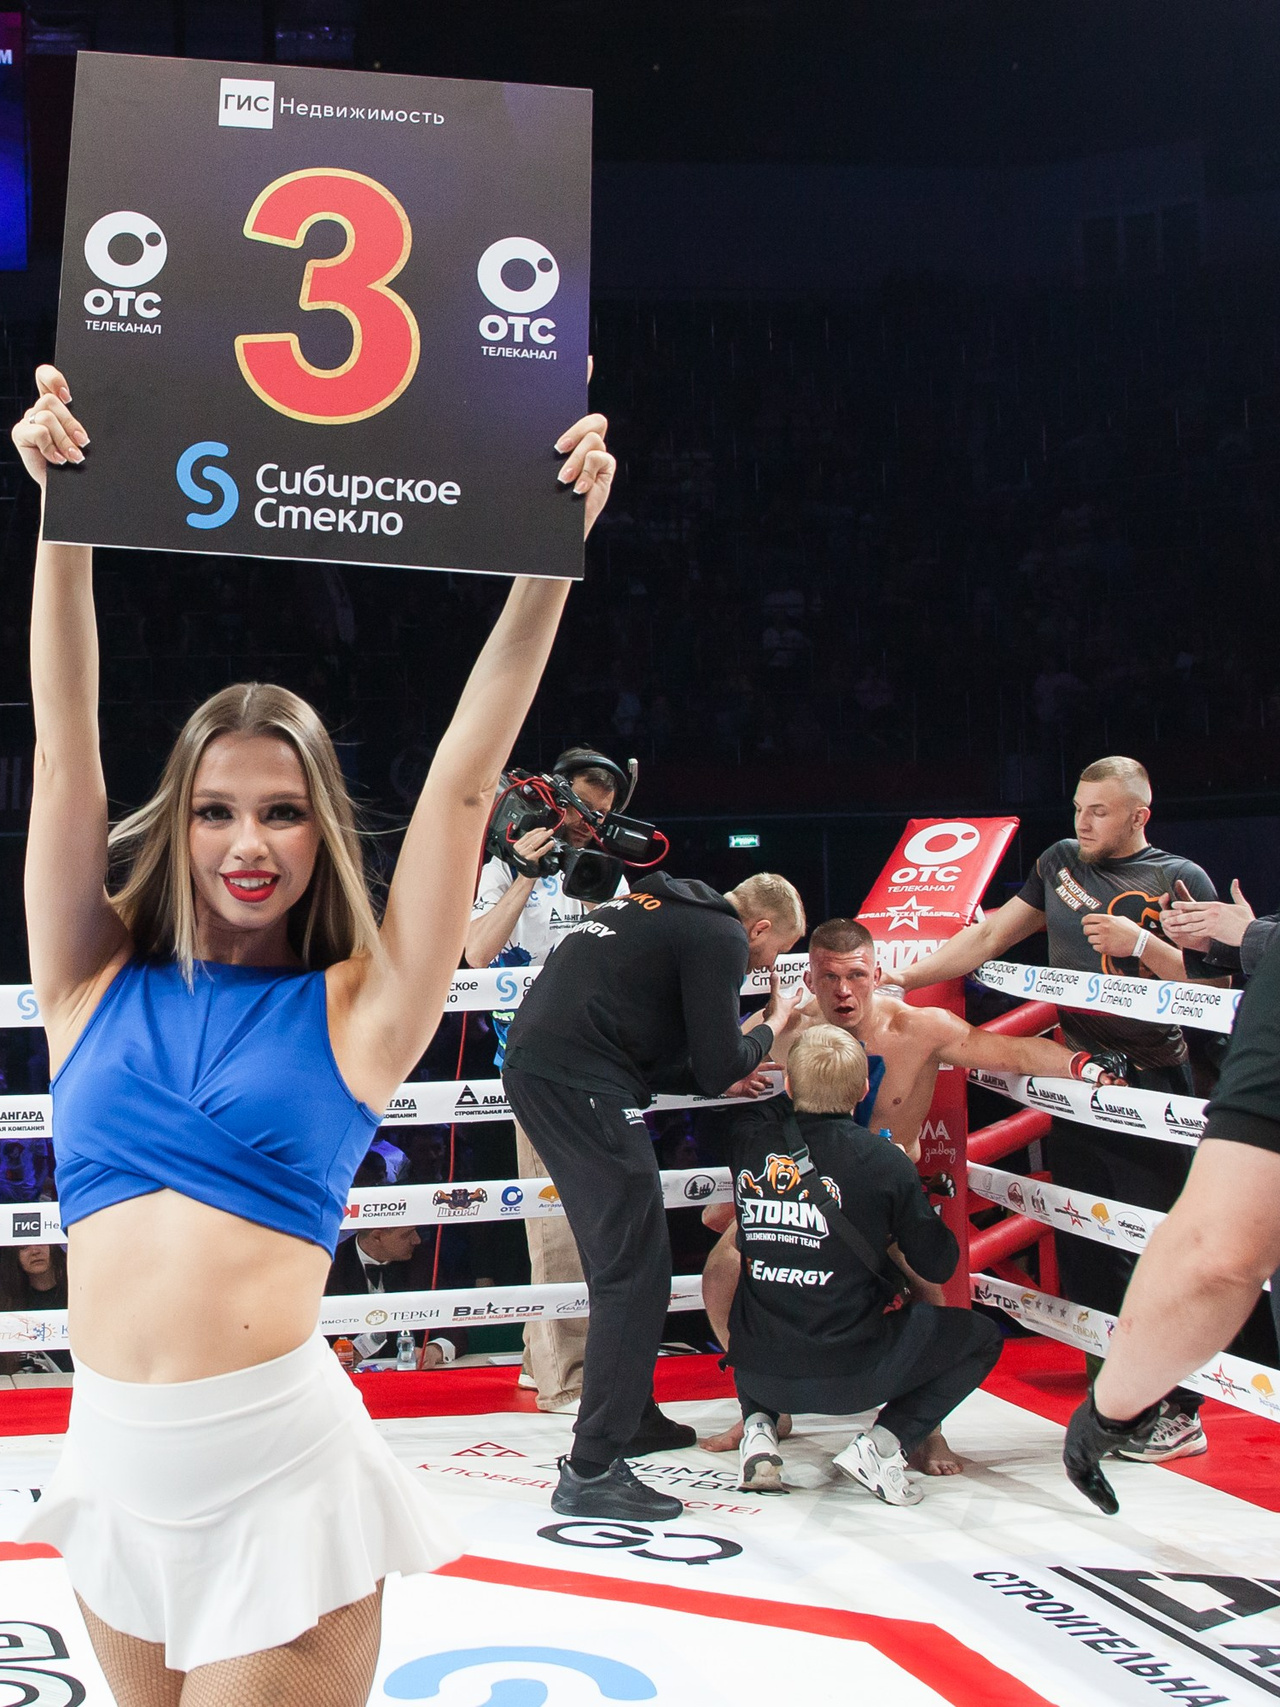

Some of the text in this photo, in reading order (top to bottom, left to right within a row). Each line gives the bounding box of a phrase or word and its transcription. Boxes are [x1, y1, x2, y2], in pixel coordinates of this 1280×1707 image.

[223, 93, 445, 126] ГИС Недвижимость
[83, 289, 162, 318] ОТС
[234, 167, 421, 425] 3
[84, 320, 162, 335] ТЕЛЕКАНАЛ
[478, 314, 557, 344] ОТС
[481, 345, 558, 361] ТЕЛЕКАНАЛ
[255, 463, 462, 505] Сибирское
[253, 498, 404, 536] Стекло
[890, 865, 963, 884] ОТС
[887, 885, 956, 894] ТЕЛЕКАНАЛ
[1057, 867, 1103, 910] MITROFANOV
[1055, 885, 1082, 911] ANTON
[1039, 968, 1080, 985] Сибирское
[1035, 980, 1065, 997] Стекло
[1102, 978, 1148, 997] Сибирское
[1174, 987, 1222, 1006] Сибирское
[1100, 991, 1133, 1008] Стекло
[1170, 1001, 1204, 1019] Стекло
[389, 1098, 417, 1110] ГАРД
[1104, 1103, 1143, 1121] АВАНГАРД
[362, 1199, 407, 1212] СТРОЙ
[362, 1210, 406, 1218] КОМПЛЕКТ
[742, 1197, 826, 1234] STORM
[14, 1221, 40, 1232] ГИС
[777, 1233, 799, 1245] FIGHT
[800, 1236, 821, 1249] TEAM
[390, 1309, 440, 1321] ТЕРКИ
[417, 1462, 558, 1490] К ПОБЕД
[972, 1570, 1231, 1707] СТРОИТЕЛЬНА
